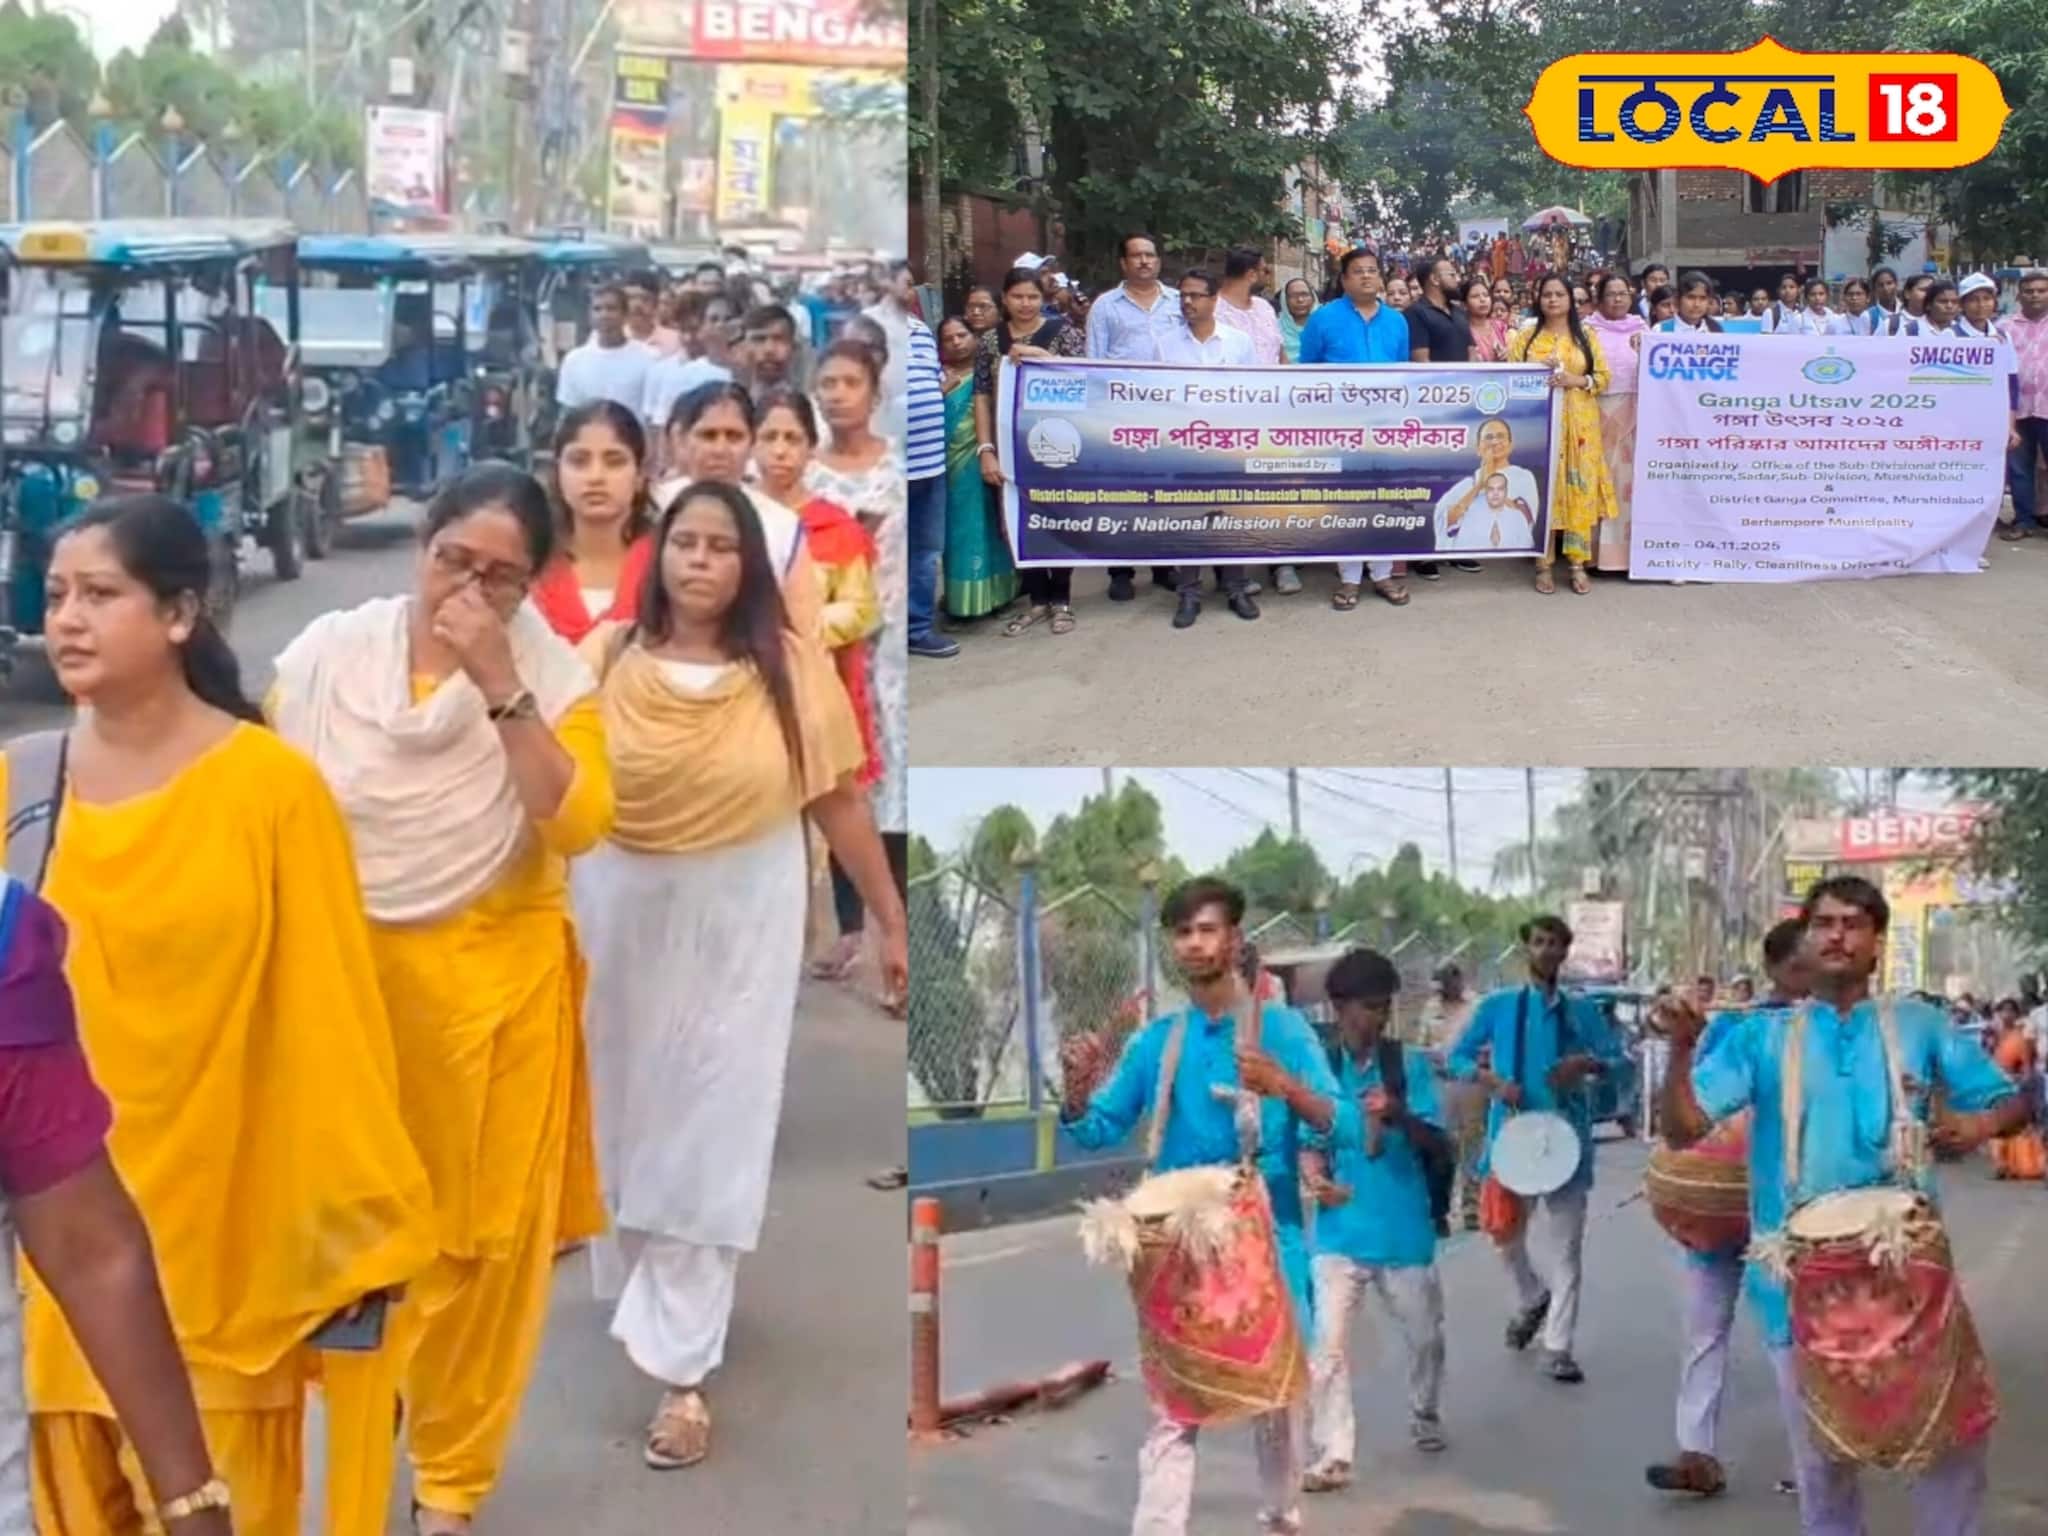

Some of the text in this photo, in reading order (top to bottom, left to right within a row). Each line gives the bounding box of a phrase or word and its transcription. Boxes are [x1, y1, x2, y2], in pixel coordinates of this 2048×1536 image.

[1671, 344, 1740, 356] NAMAMI
[1910, 346, 1995, 365] SMCGWB
[1649, 343, 1740, 381] GANGE
[1110, 382, 1175, 403] River
[1184, 384, 1280, 404] Festival
[1418, 386, 1472, 404] 2025
[1698, 392, 1937, 411] Ganga Utsav 2025
[1765, 410, 1834, 428] উৎসব
[1841, 415, 1904, 428] ২০২৫
[1112, 427, 1159, 449] গঙ্গা
[1269, 427, 1364, 450] আমাদের
[1794, 437, 1887, 450] আমাদের
[1314, 459, 1328, 471] by
[1648, 460, 1719, 470] Organized
[1752, 461, 1793, 470] Office
[1796, 461, 1810, 470] of
[1814, 461, 1835, 470] the
[1874, 472, 1964, 481] Murshidabad
[1710, 495, 1760, 504] District
[1764, 495, 1807, 505] Ganga
[1893, 496, 1984, 504] Murshidabad
[1028, 514, 1426, 535] Started By: National Mission For Clean Ganga
[1741, 518, 1914, 528] Berhampore Municipality
[1644, 539, 1680, 549] Date
[1694, 540, 1781, 551] 04.11.2025
[1647, 560, 1700, 569] Activity
[1713, 560, 1751, 569] Rally,
[1755, 560, 1837, 570] Cleanliness
